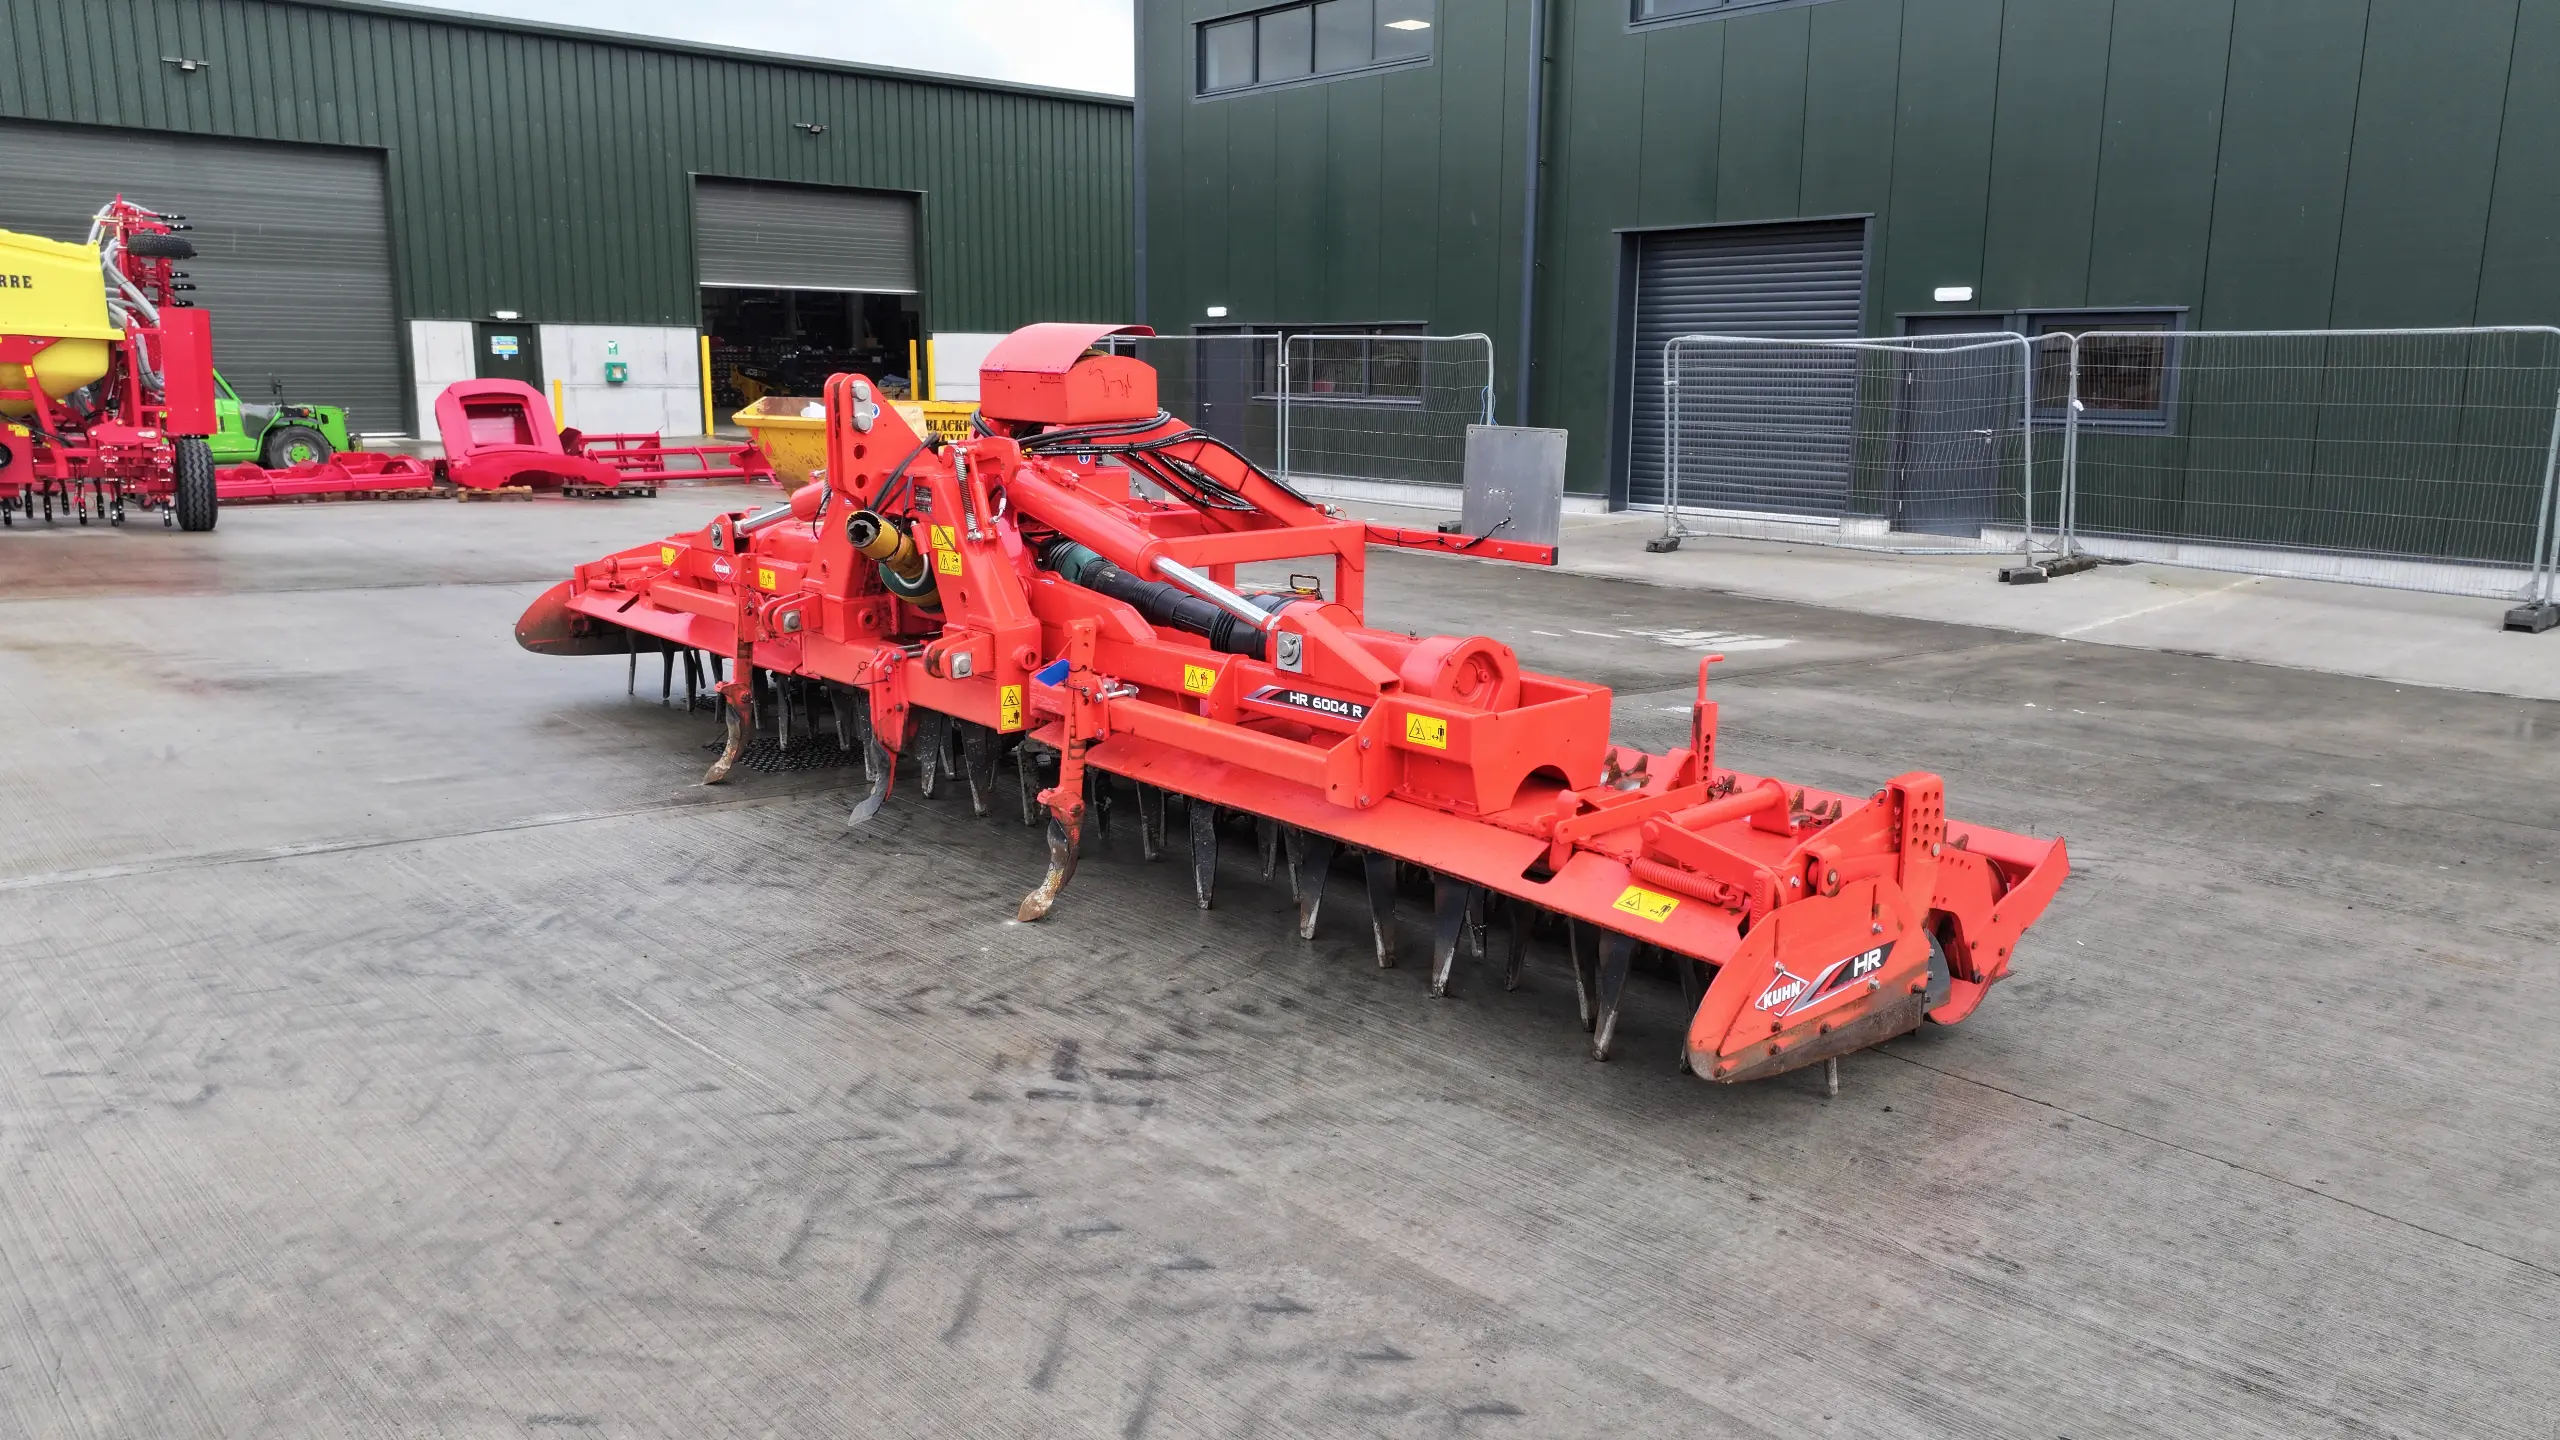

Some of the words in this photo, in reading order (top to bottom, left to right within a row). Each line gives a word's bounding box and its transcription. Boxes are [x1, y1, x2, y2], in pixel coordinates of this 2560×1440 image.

[0, 274, 33, 289] RRE
[926, 419, 972, 432] BLACKP
[1289, 691, 1309, 707] HR
[1312, 697, 1349, 715] 6004
[1352, 704, 1363, 718] R
[1853, 948, 1882, 978] HR
[1763, 980, 1802, 1009] KUHN
